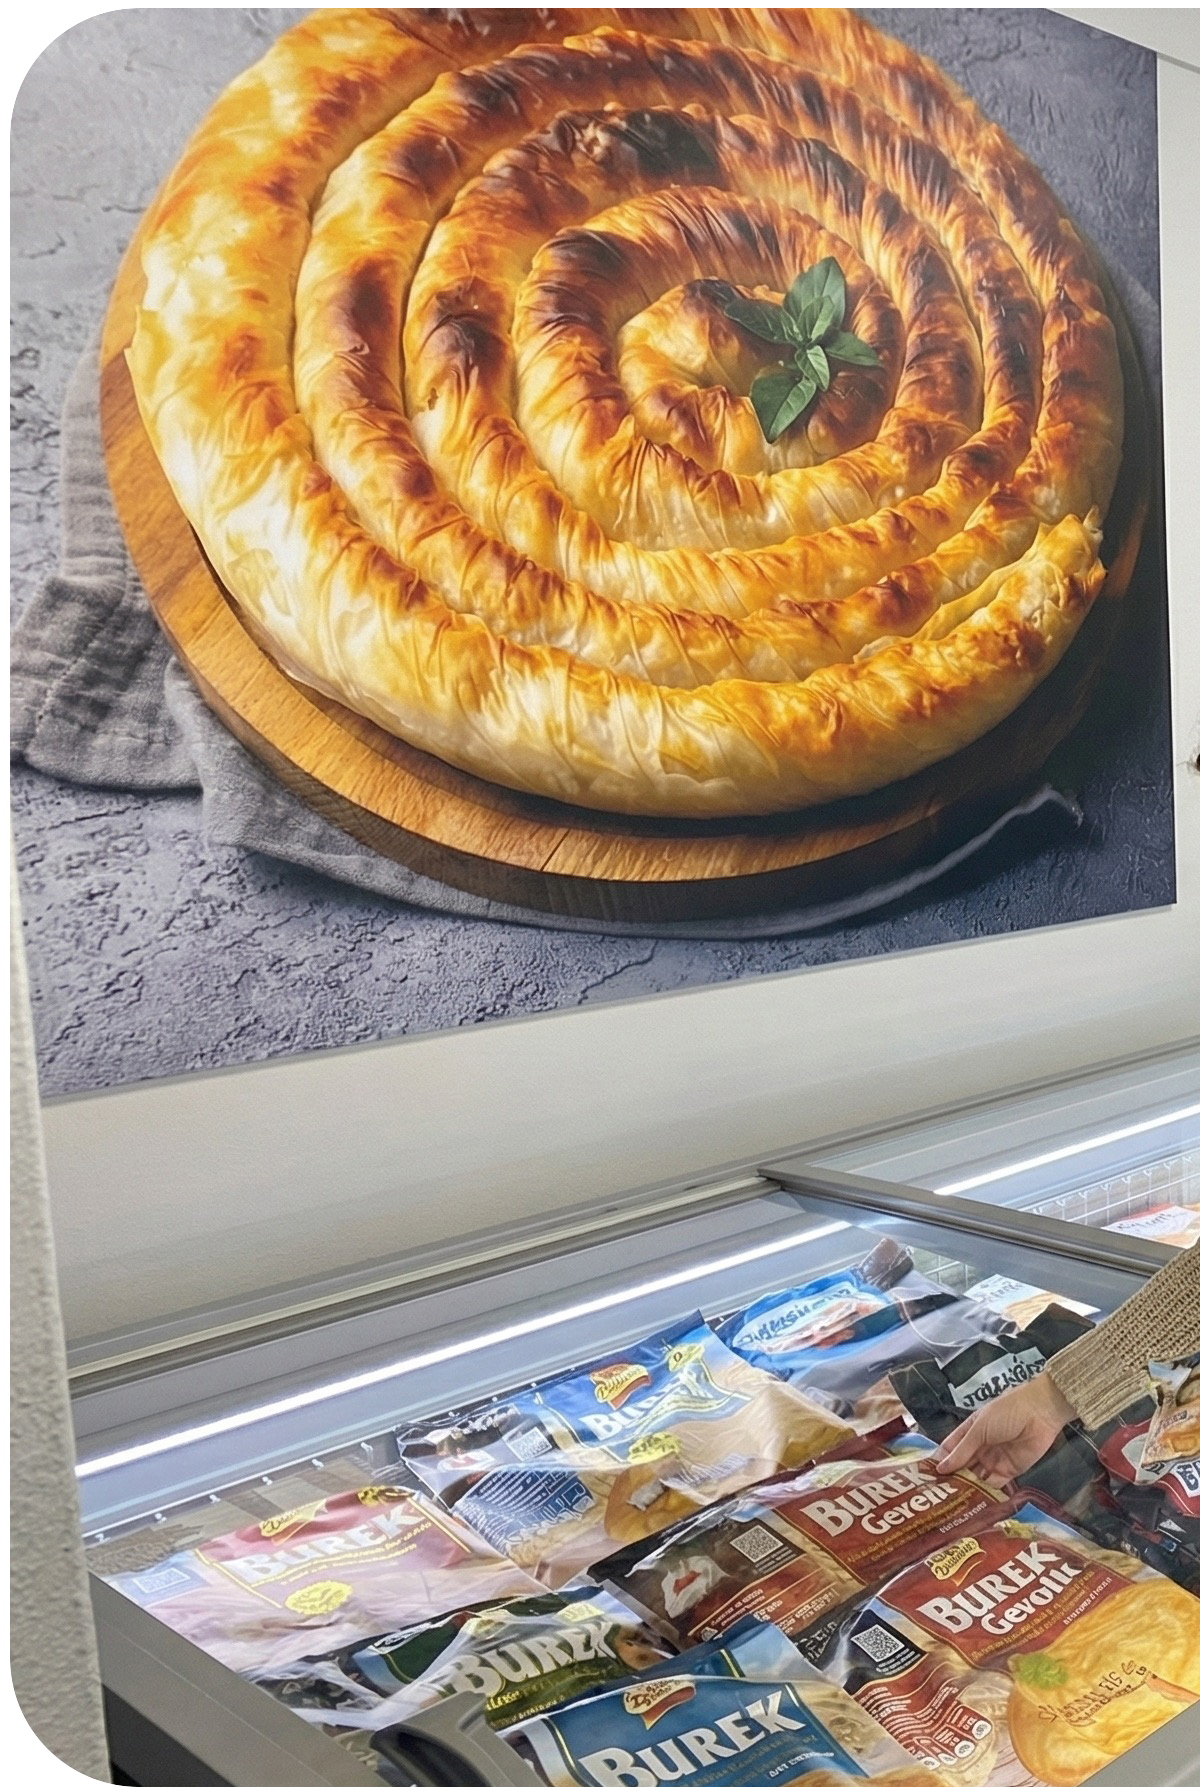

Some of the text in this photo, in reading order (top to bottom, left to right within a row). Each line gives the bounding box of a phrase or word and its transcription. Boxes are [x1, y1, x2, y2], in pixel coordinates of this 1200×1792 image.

[800, 1460, 937, 1537] BUREK
[225, 1505, 428, 1585] BUREK
[916, 1541, 1062, 1634] BUREK
[451, 1621, 617, 1697] BUREK
[578, 1690, 806, 1787] BUREK
